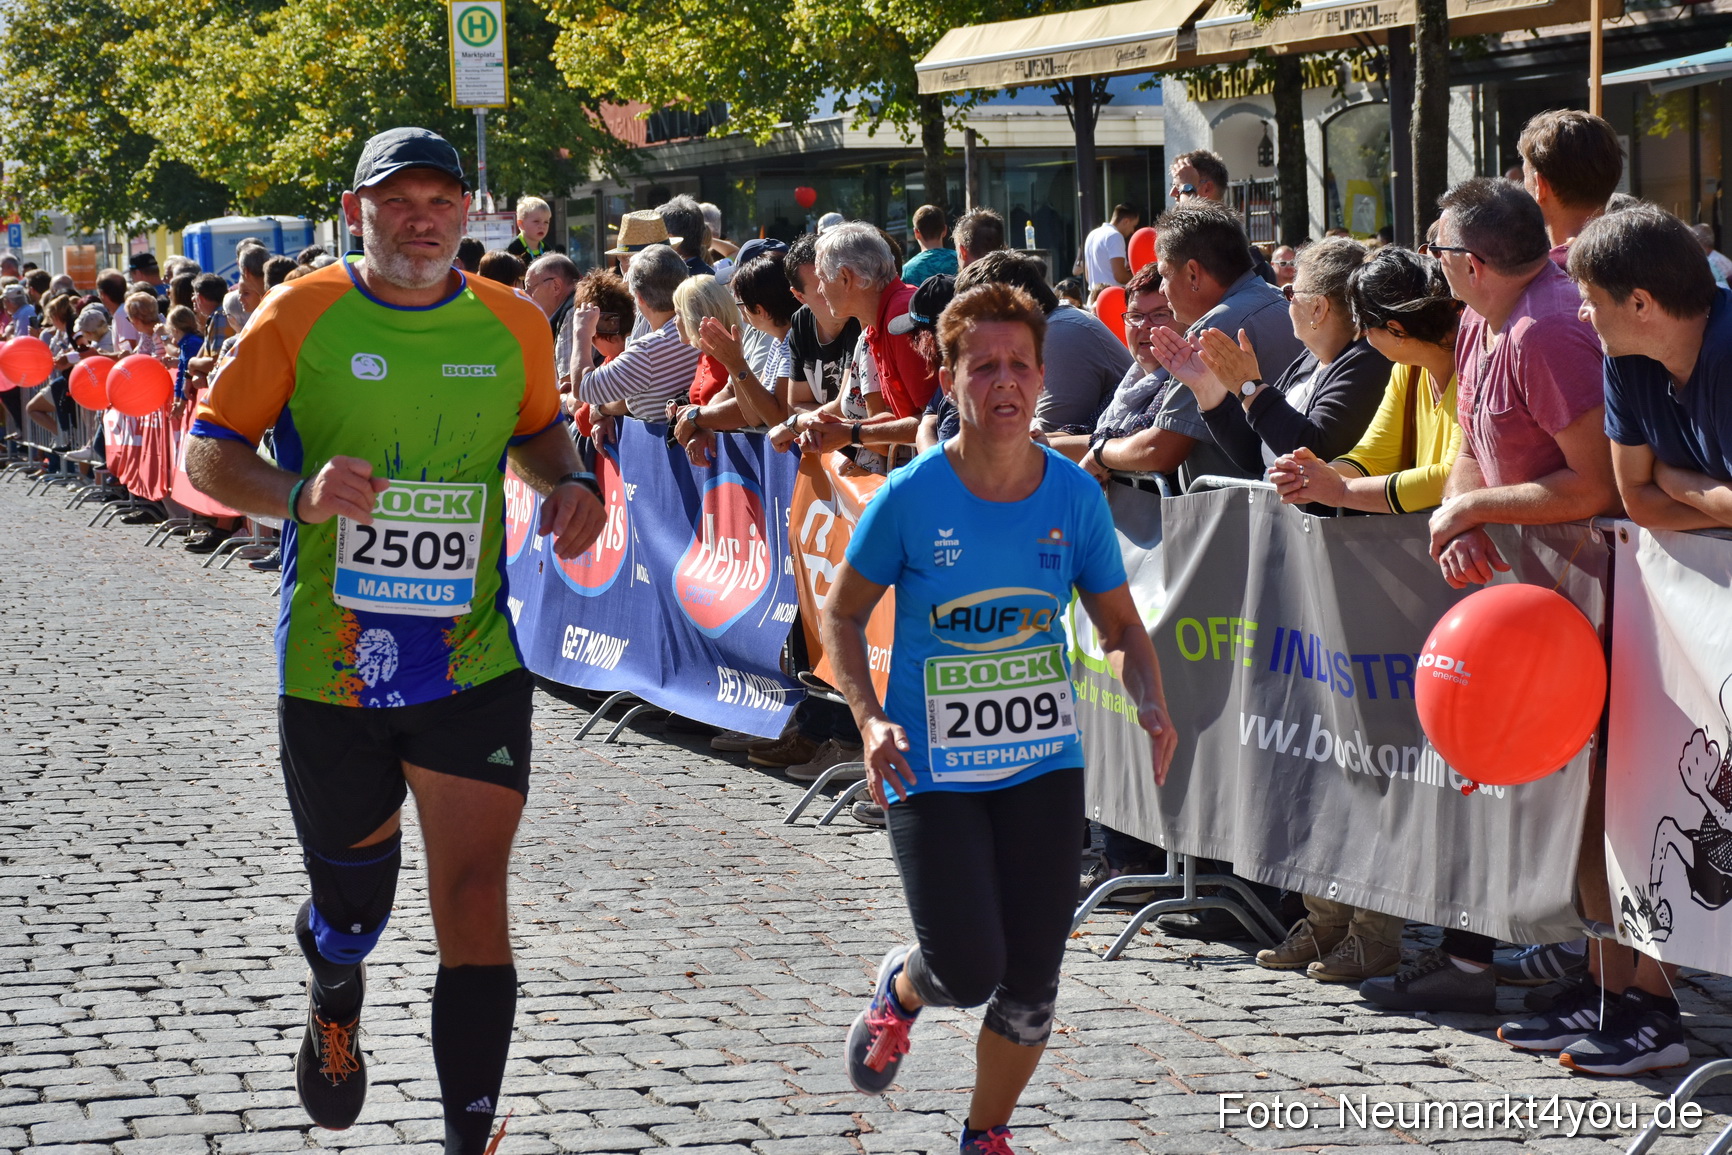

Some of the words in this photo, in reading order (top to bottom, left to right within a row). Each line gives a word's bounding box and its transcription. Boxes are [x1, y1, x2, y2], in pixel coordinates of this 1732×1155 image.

[462, 51, 495, 59] Marktplatz
[442, 364, 497, 377] BOCK
[504, 478, 532, 534] ervis
[352, 524, 466, 571] 2509
[684, 513, 766, 600] Hervis
[934, 539, 960, 547] erima
[357, 578, 455, 601] MARKUS
[683, 585, 718, 606] SPORTS
[562, 624, 589, 661] GET
[716, 665, 742, 705] GET
[936, 651, 1060, 691] BOCK
[1433, 670, 1469, 686] energie
[1090, 677, 1099, 711] by
[946, 692, 1059, 739] 2009
[945, 741, 1064, 767] STEPHANIE
[466, 1105, 493, 1114] adidas
